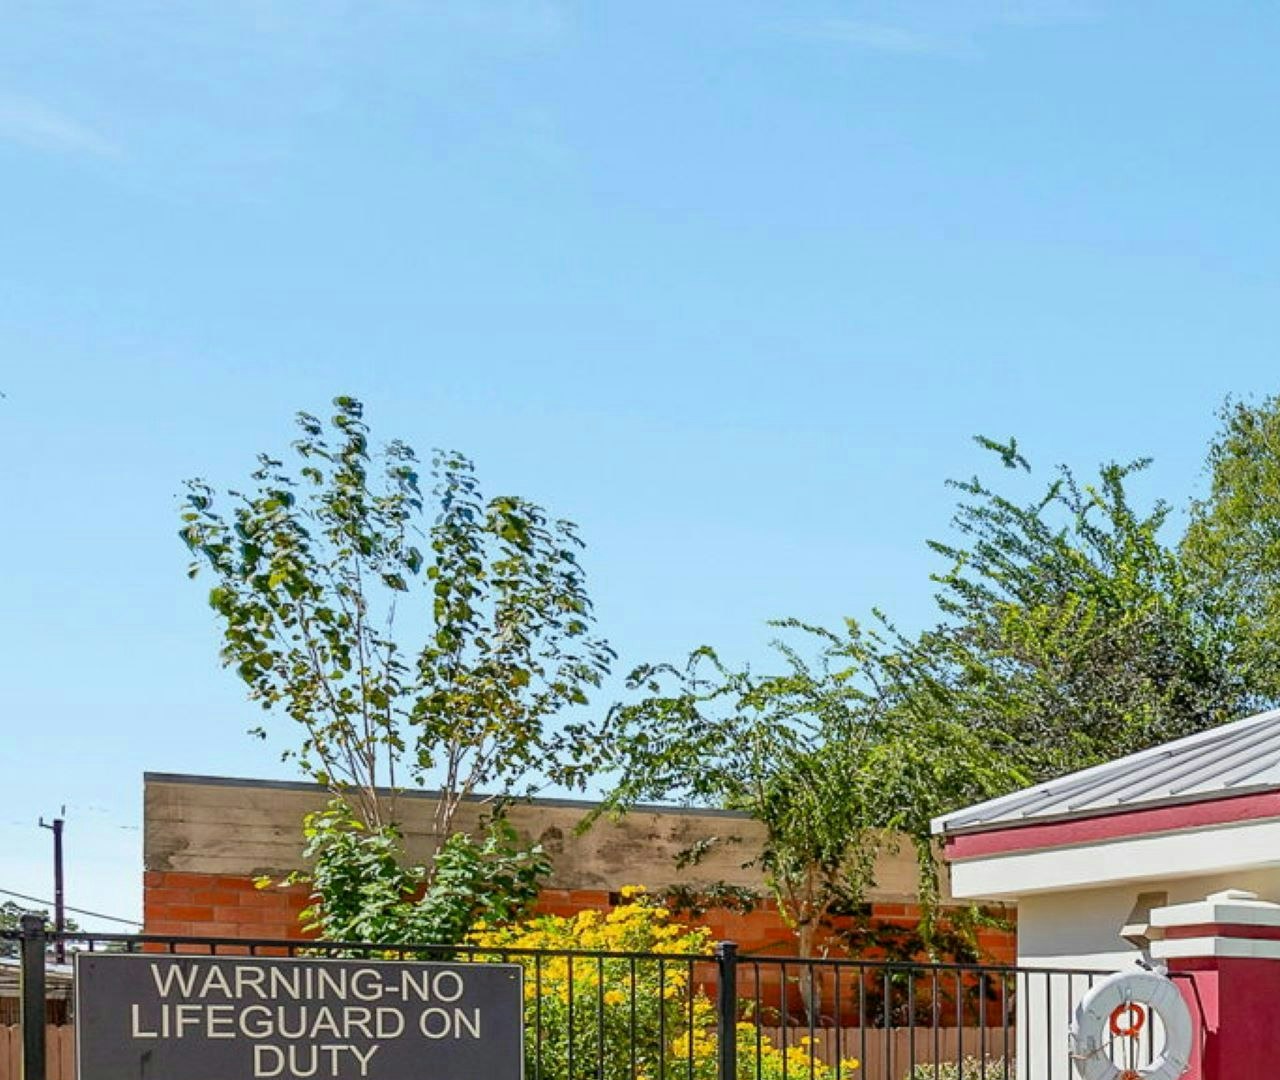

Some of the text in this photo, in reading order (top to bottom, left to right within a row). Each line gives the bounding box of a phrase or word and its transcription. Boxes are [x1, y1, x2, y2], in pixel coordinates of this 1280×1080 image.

[151, 964, 464, 1003] WARNING-NO
[131, 1004, 481, 1040] LIFEGUARD ON
[254, 1044, 380, 1078] DUTY
